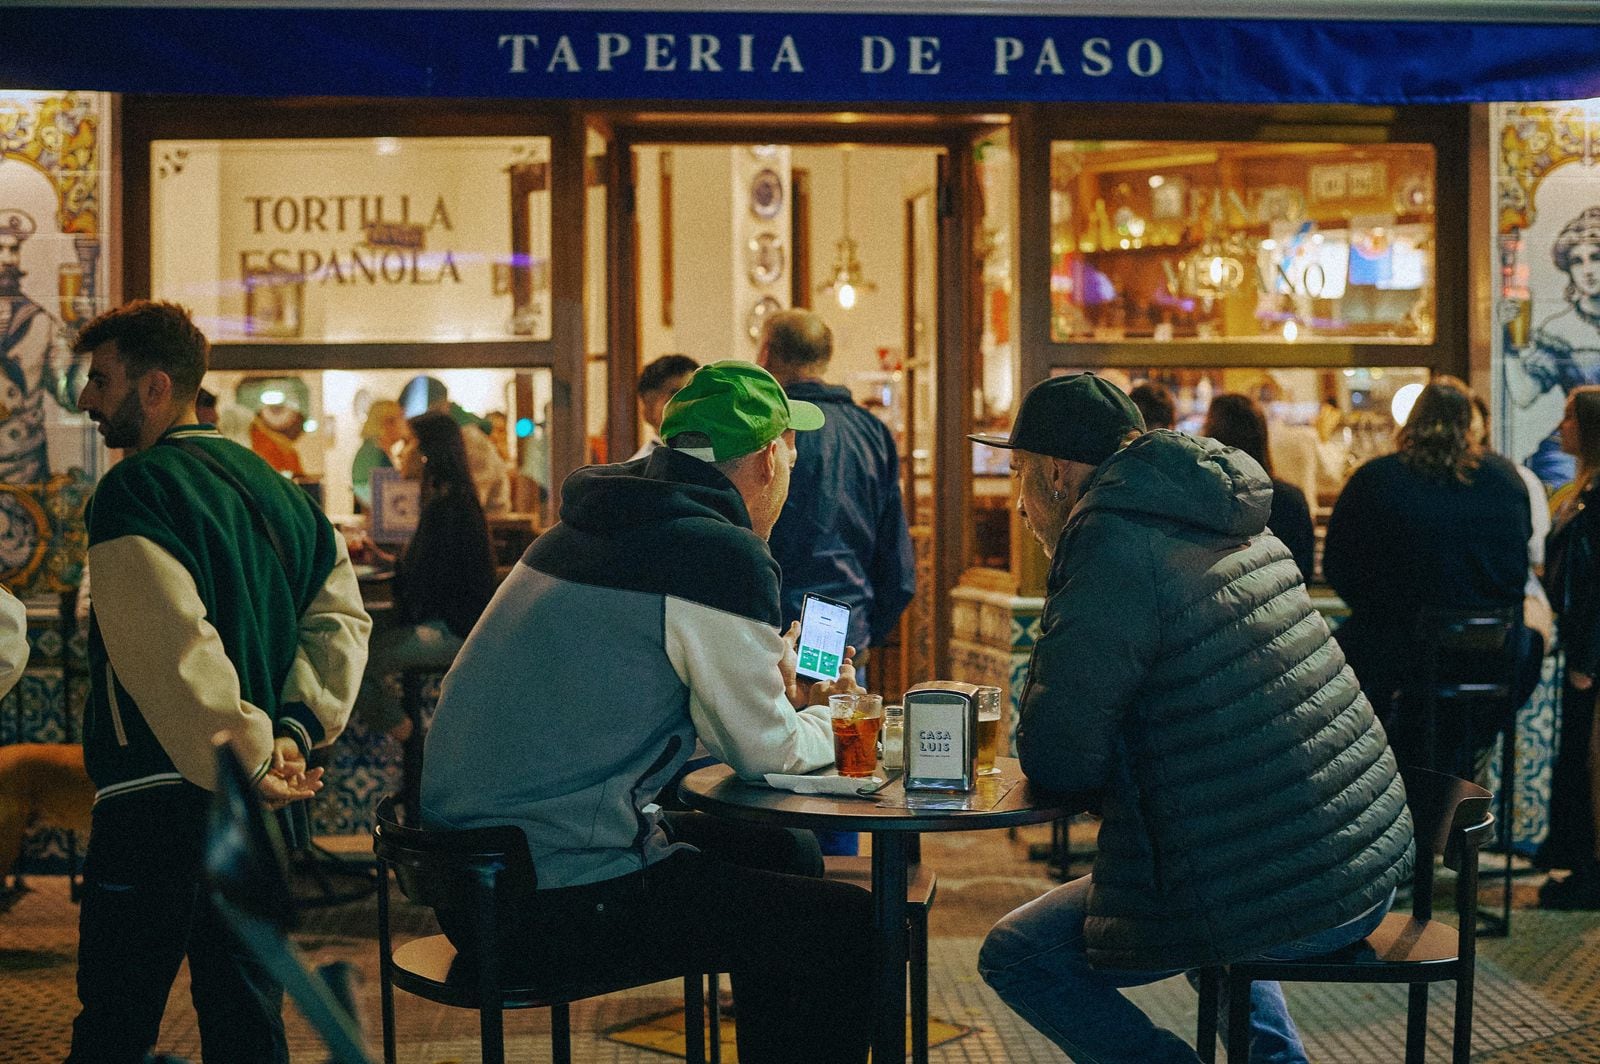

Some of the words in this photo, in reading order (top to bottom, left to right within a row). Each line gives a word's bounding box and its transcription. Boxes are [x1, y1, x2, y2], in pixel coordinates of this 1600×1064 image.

[498, 33, 804, 73] TAPERIA
[860, 35, 942, 75] DE
[994, 37, 1163, 77] PASO
[244, 195, 454, 233] TORTILLA
[919, 730, 952, 740] CASA
[919, 741, 951, 752] LUIS
